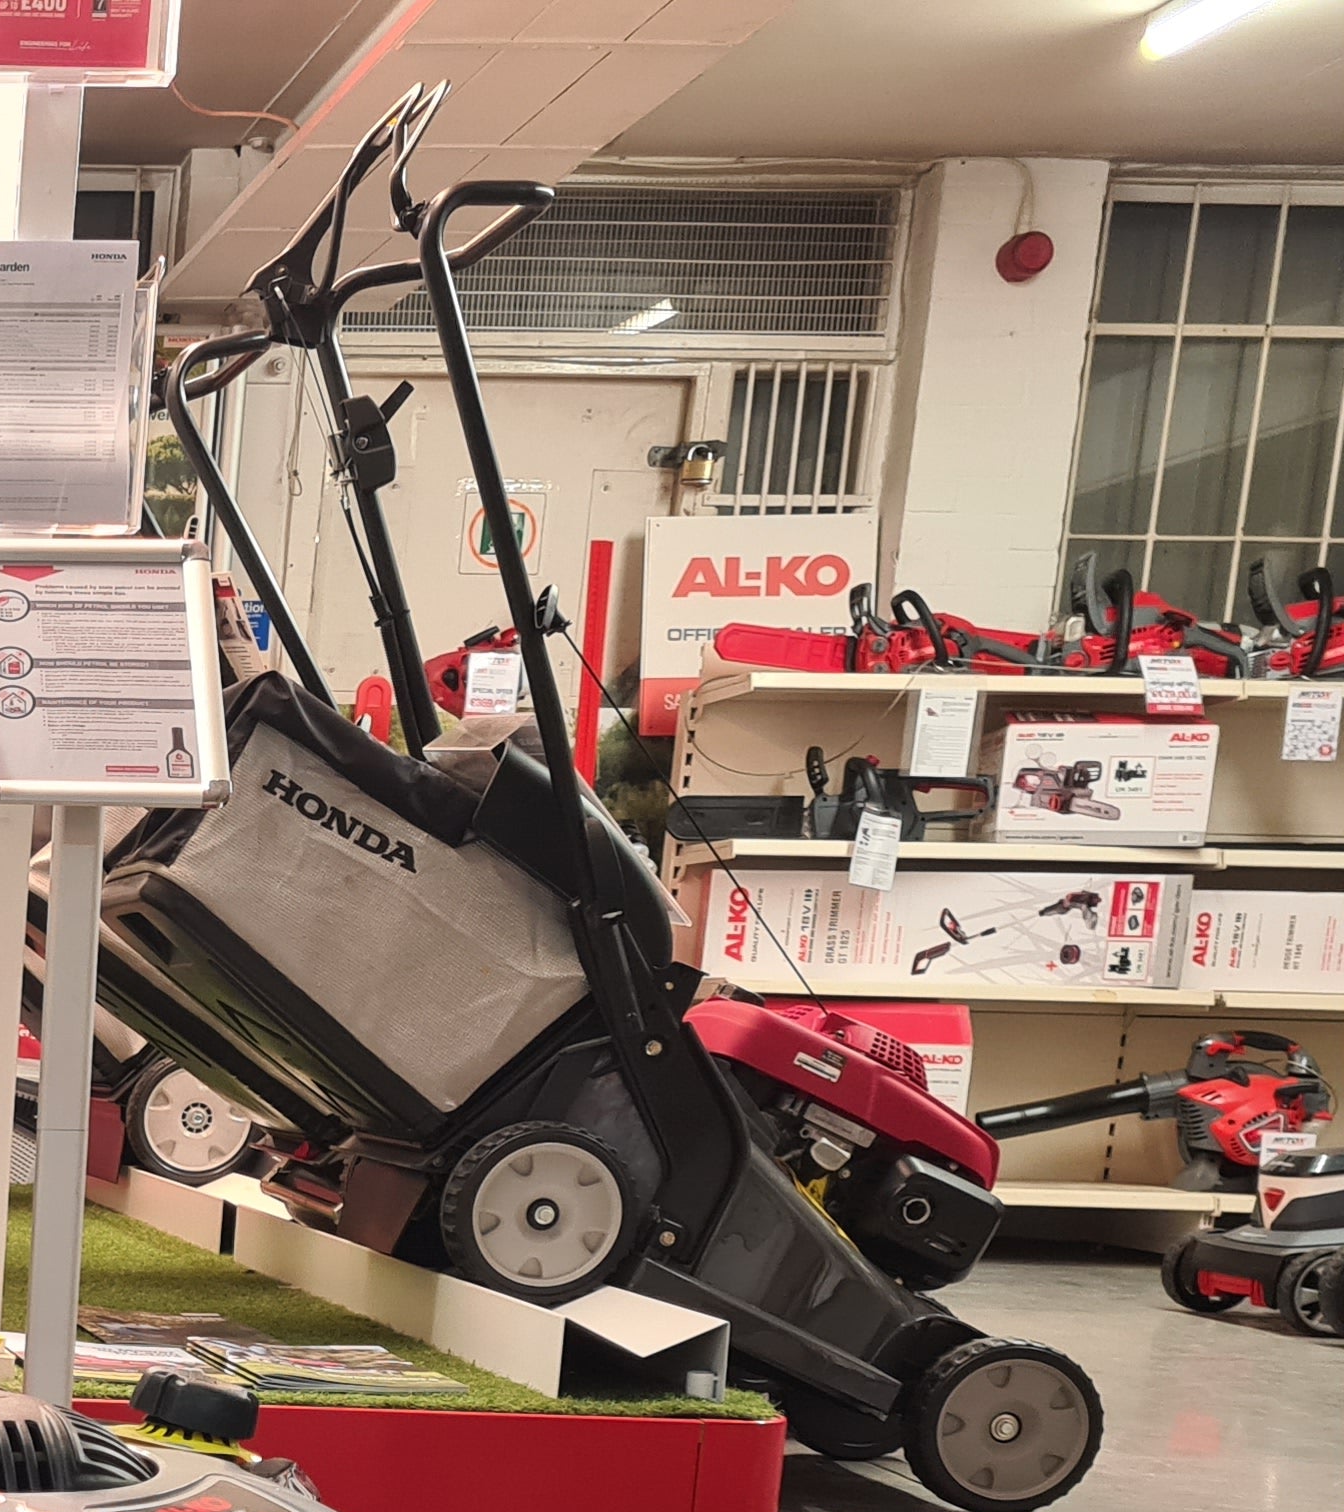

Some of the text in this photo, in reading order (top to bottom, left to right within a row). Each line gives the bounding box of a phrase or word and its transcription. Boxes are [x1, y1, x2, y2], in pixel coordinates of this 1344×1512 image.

[90, 253, 128, 261] HONDA
[672, 554, 851, 598] AL-KO
[1169, 732, 1211, 743] AL-KO
[262, 768, 418, 874] HONDA
[723, 886, 752, 963] AL-KO
[824, 890, 842, 964] GRASS TRIMMER
[1192, 912, 1213, 968] AL-KO
[1273, 1136, 1306, 1145] MITOX
